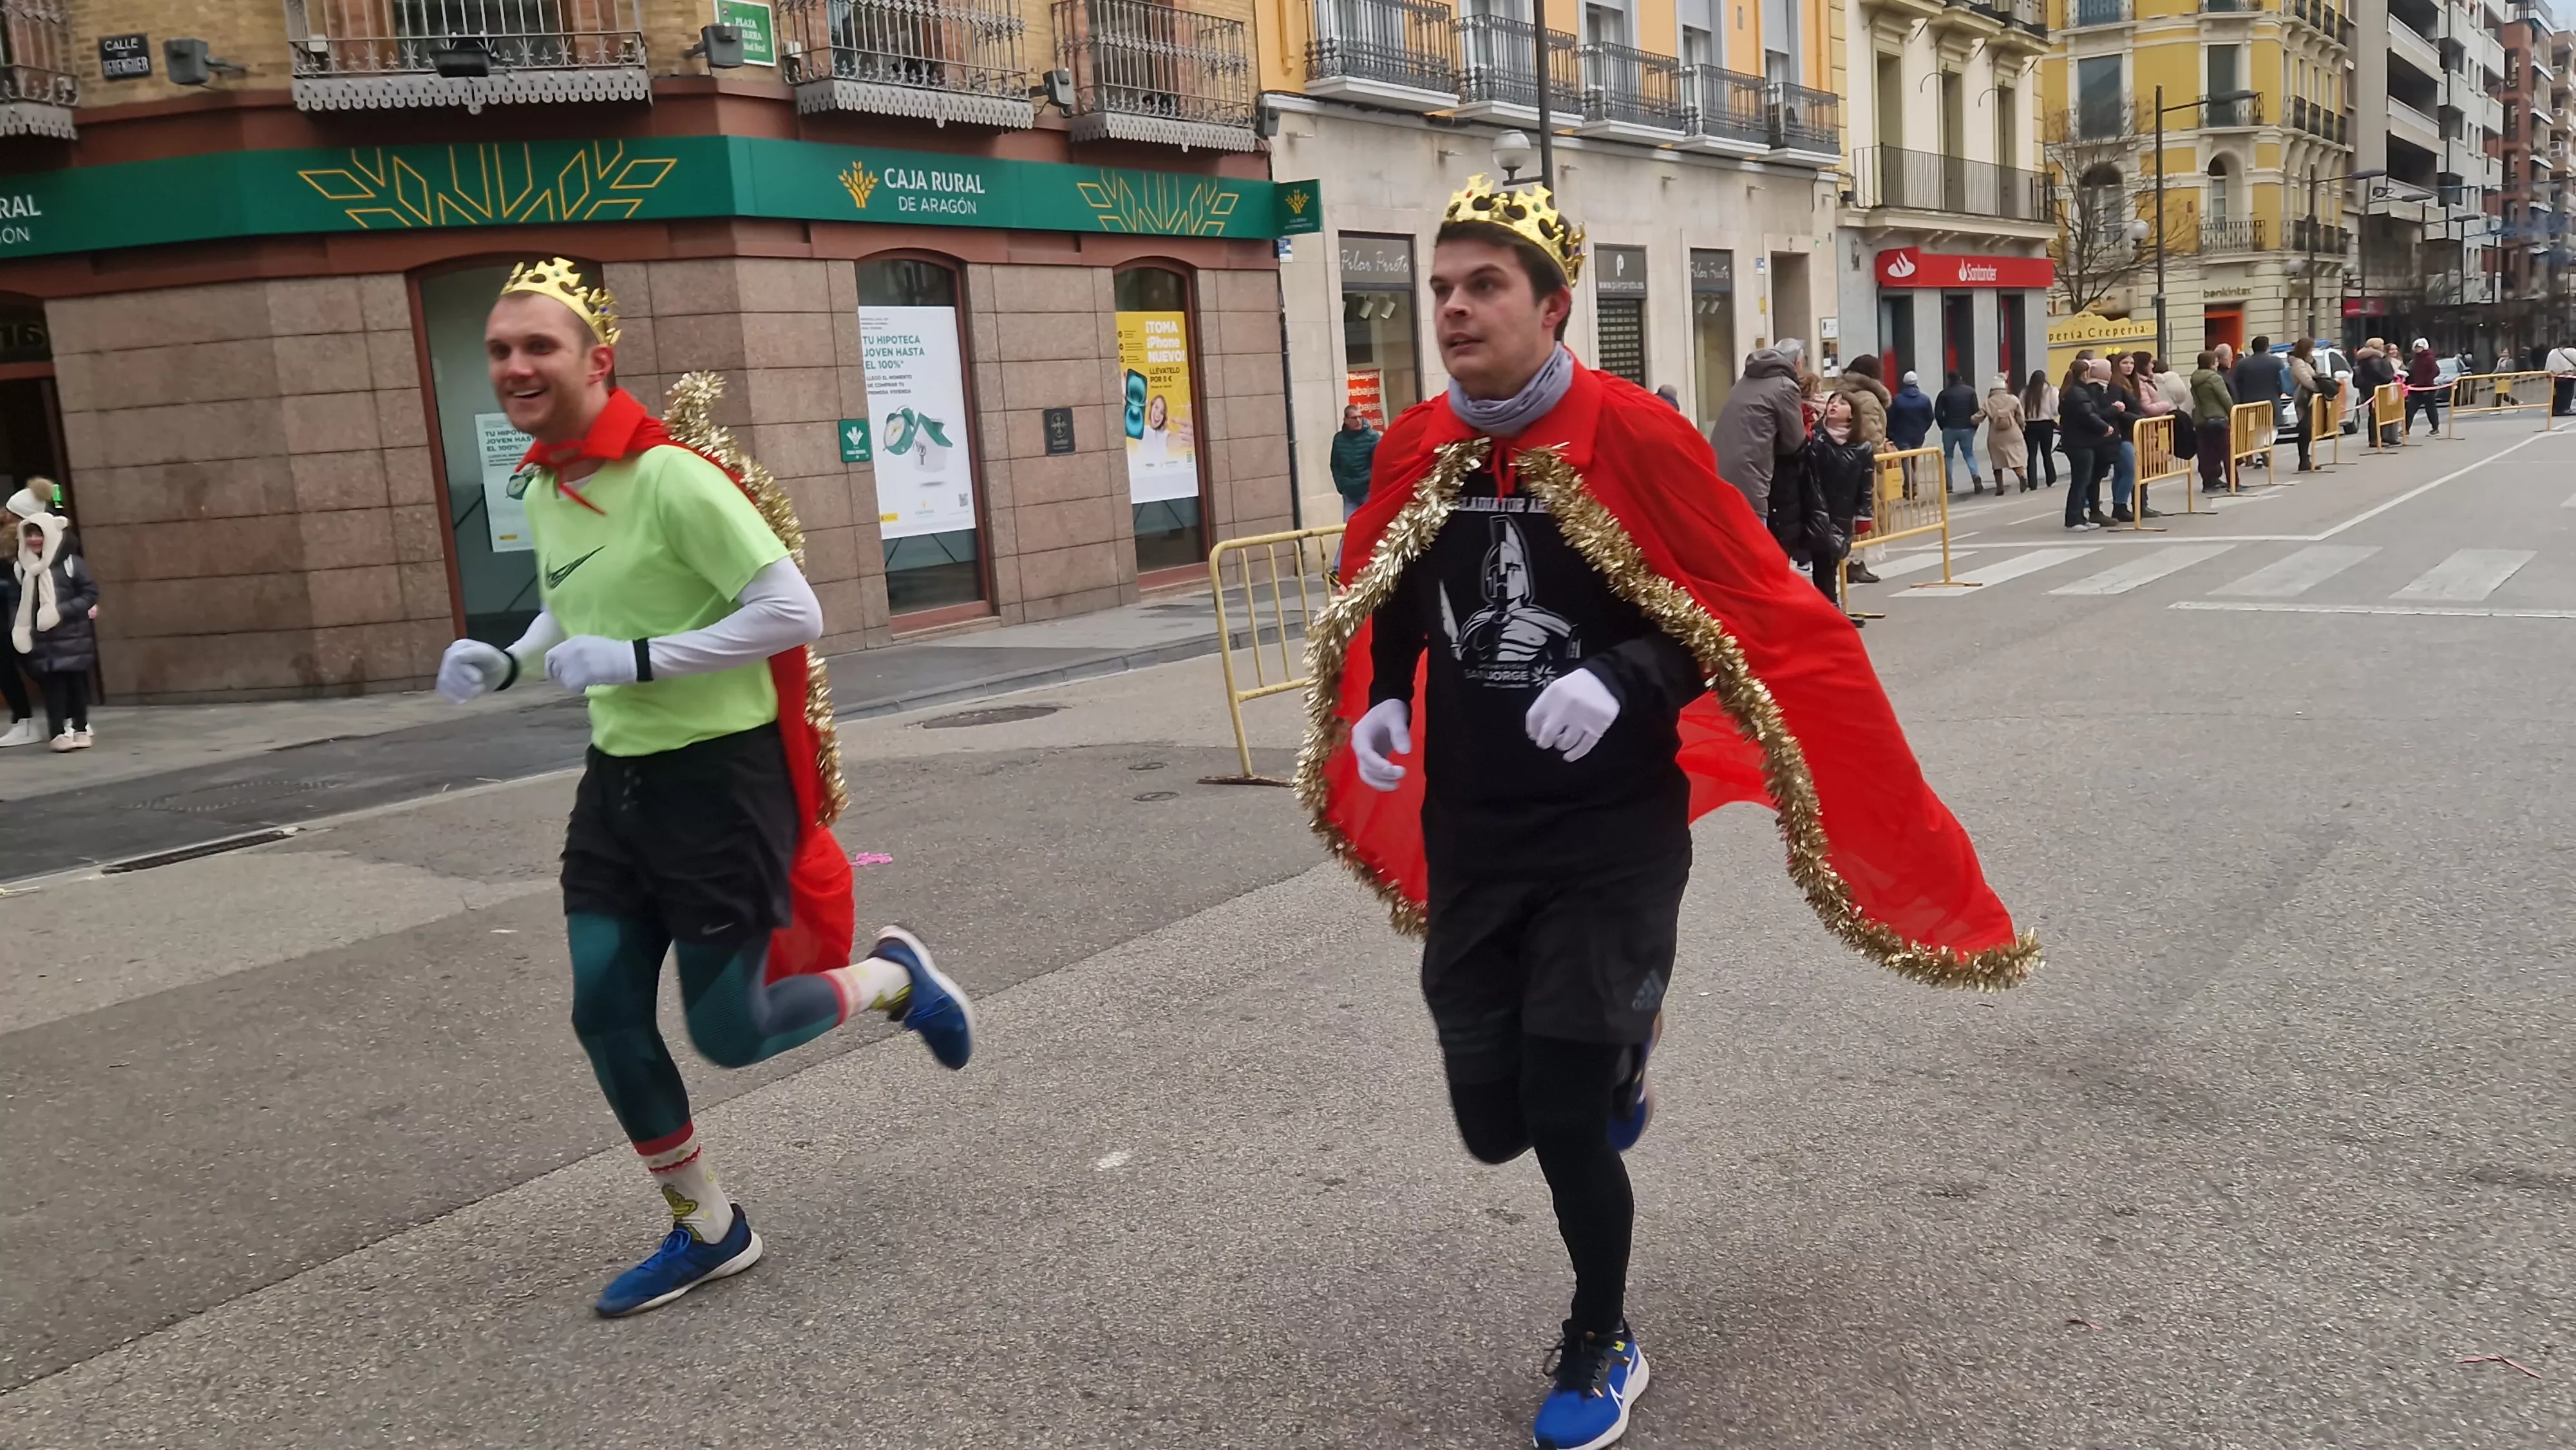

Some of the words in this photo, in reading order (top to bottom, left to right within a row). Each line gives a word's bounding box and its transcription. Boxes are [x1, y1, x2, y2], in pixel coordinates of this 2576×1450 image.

[735, 17, 757, 29] PLAZA
[105, 37, 138, 51] CALLE
[884, 167, 928, 191] CAJA
[931, 171, 985, 194] RURAL
[898, 196, 916, 211] DE
[920, 196, 977, 214] ARAGÓN
[1967, 263, 1997, 281] Santander
[2203, 287, 2251, 298] bankinter
[862, 336, 875, 344] TU
[876, 335, 921, 344] HIPOTECA
[2049, 329, 2082, 342] peria
[864, 348, 893, 357] JOVEN
[896, 347, 925, 356] HASTA
[1148, 350, 1186, 362] NUEVO!
[865, 361, 876, 370] EL
[1348, 386, 1380, 398] rebajas
